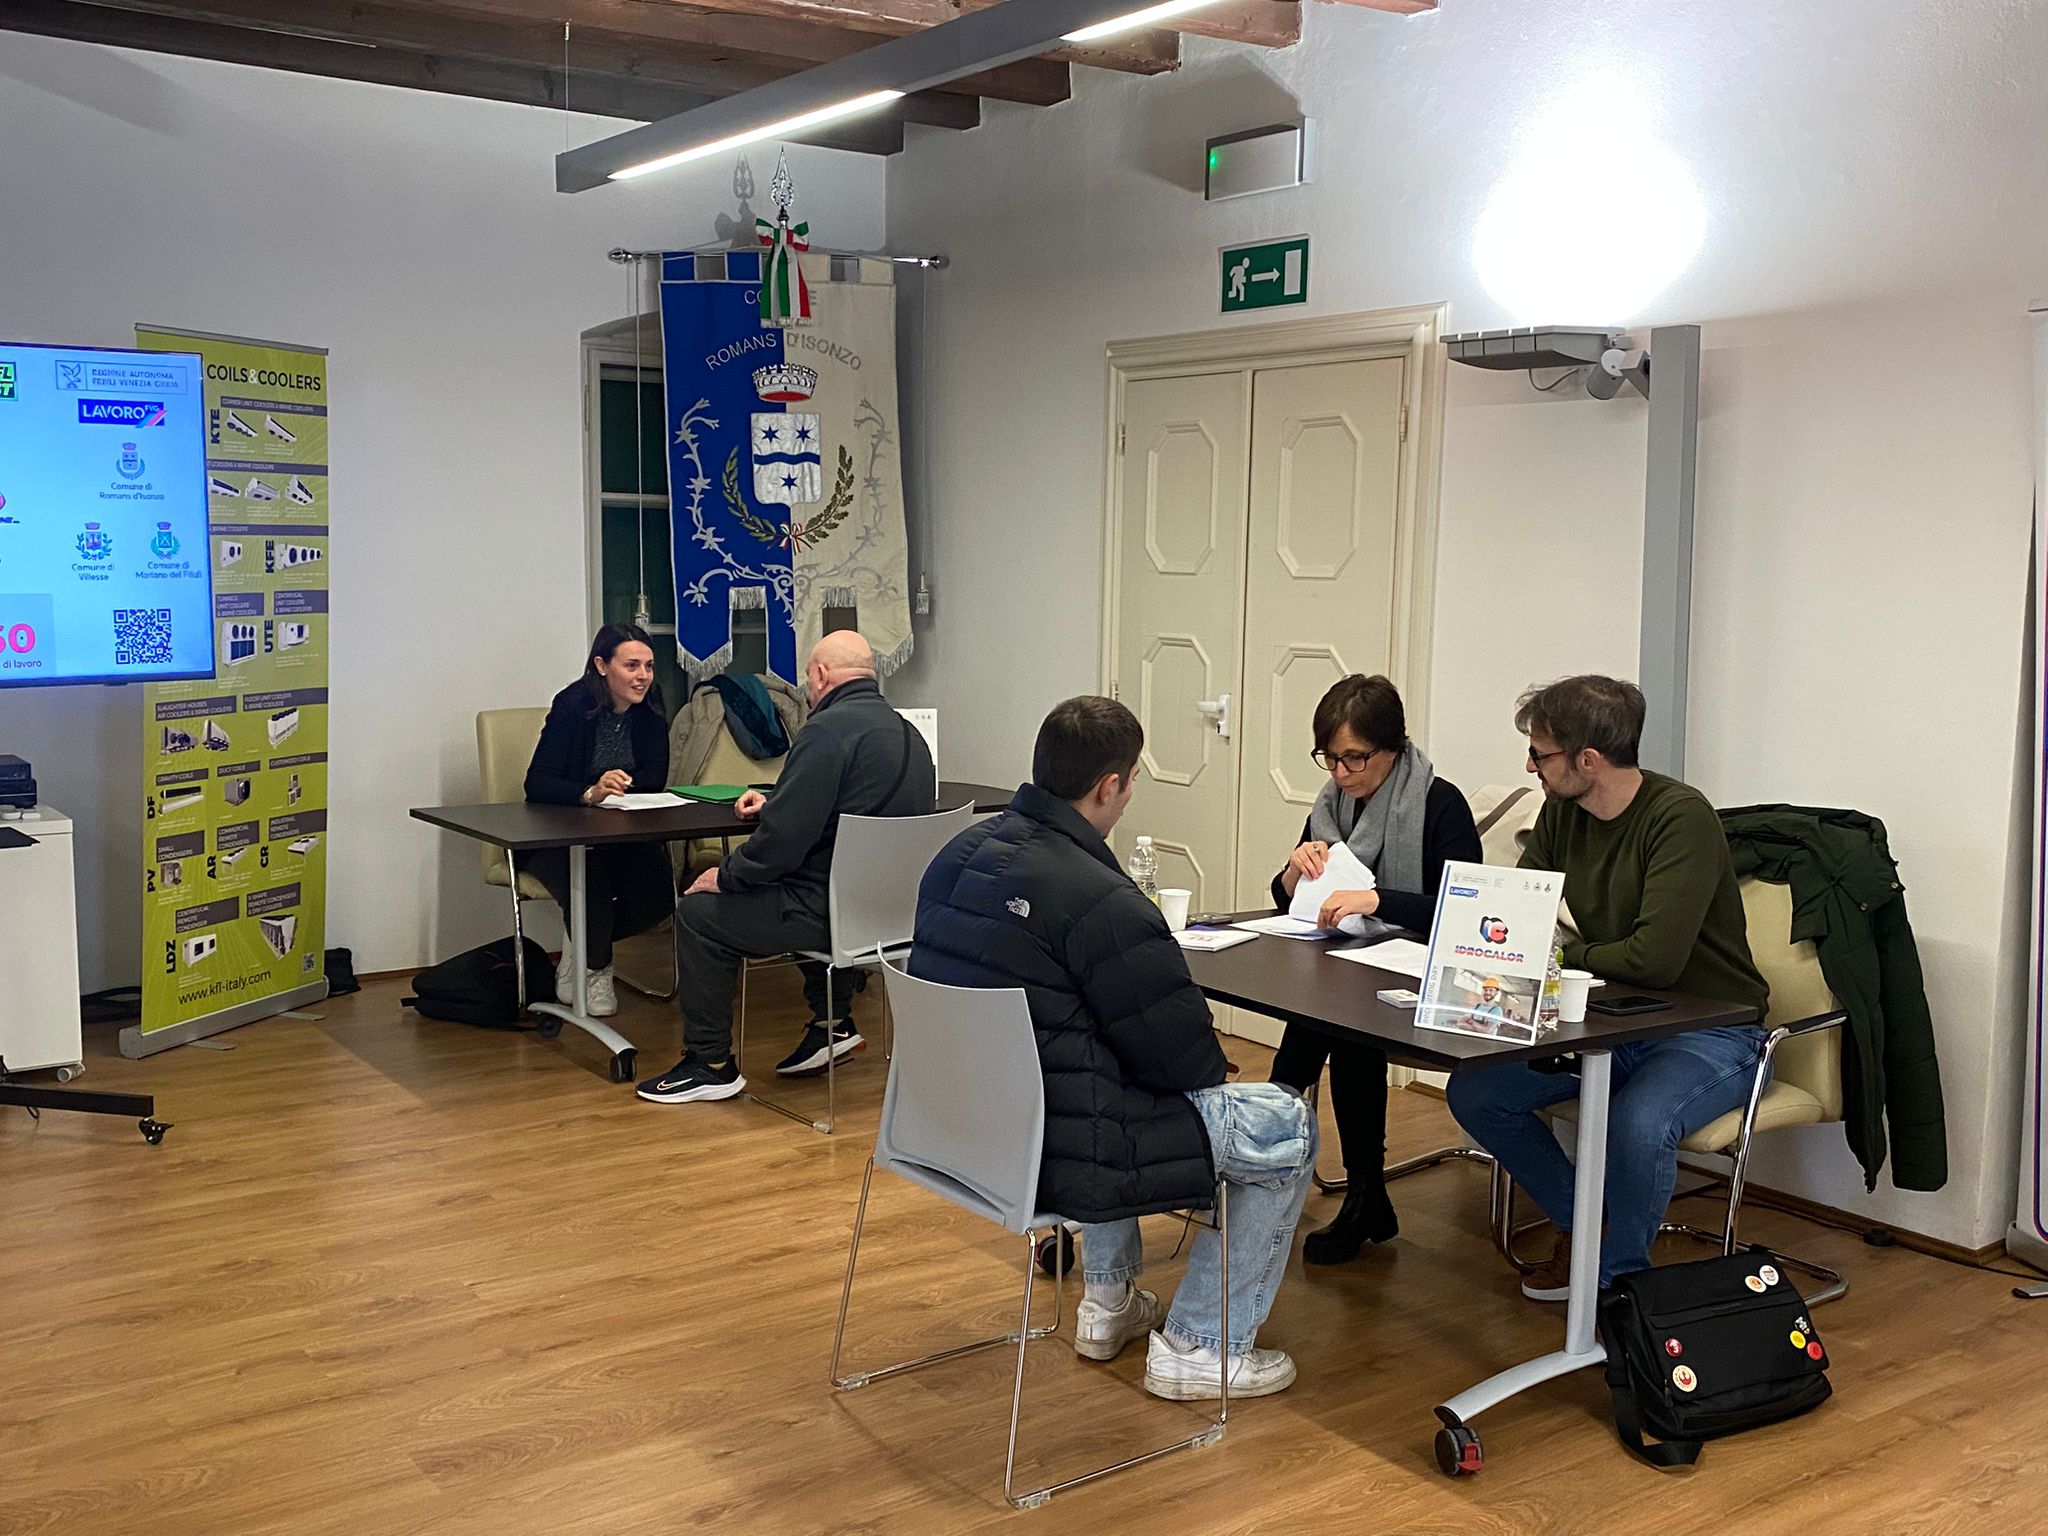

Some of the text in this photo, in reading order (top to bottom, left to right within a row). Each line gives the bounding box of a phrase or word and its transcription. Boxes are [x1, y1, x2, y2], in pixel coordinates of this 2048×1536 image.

[705, 332, 862, 371] ROMANS D'ISONZO
[92, 368, 173, 380] REGIONE AUTONOMA
[83, 404, 145, 419] LAVORO
[211, 409, 220, 444] KTE
[111, 483, 153, 491] Comune di
[100, 492, 131, 500] Romans
[265, 540, 274, 573] KFE
[72, 563, 115, 572] Comune di
[148, 561, 189, 570] Comune di
[79, 573, 109, 581] Villesse
[135, 571, 167, 579] Mariano
[169, 570, 182, 578] del
[264, 620, 274, 653] UTE
[3, 660, 42, 668] di lavoro
[207, 855, 216, 879] AR
[147, 869, 156, 892] PV
[166, 939, 176, 974] LDZ
[1454, 944, 1524, 963] IDROCALOR
[178, 969, 271, 1005] www.kfl-italy.com
